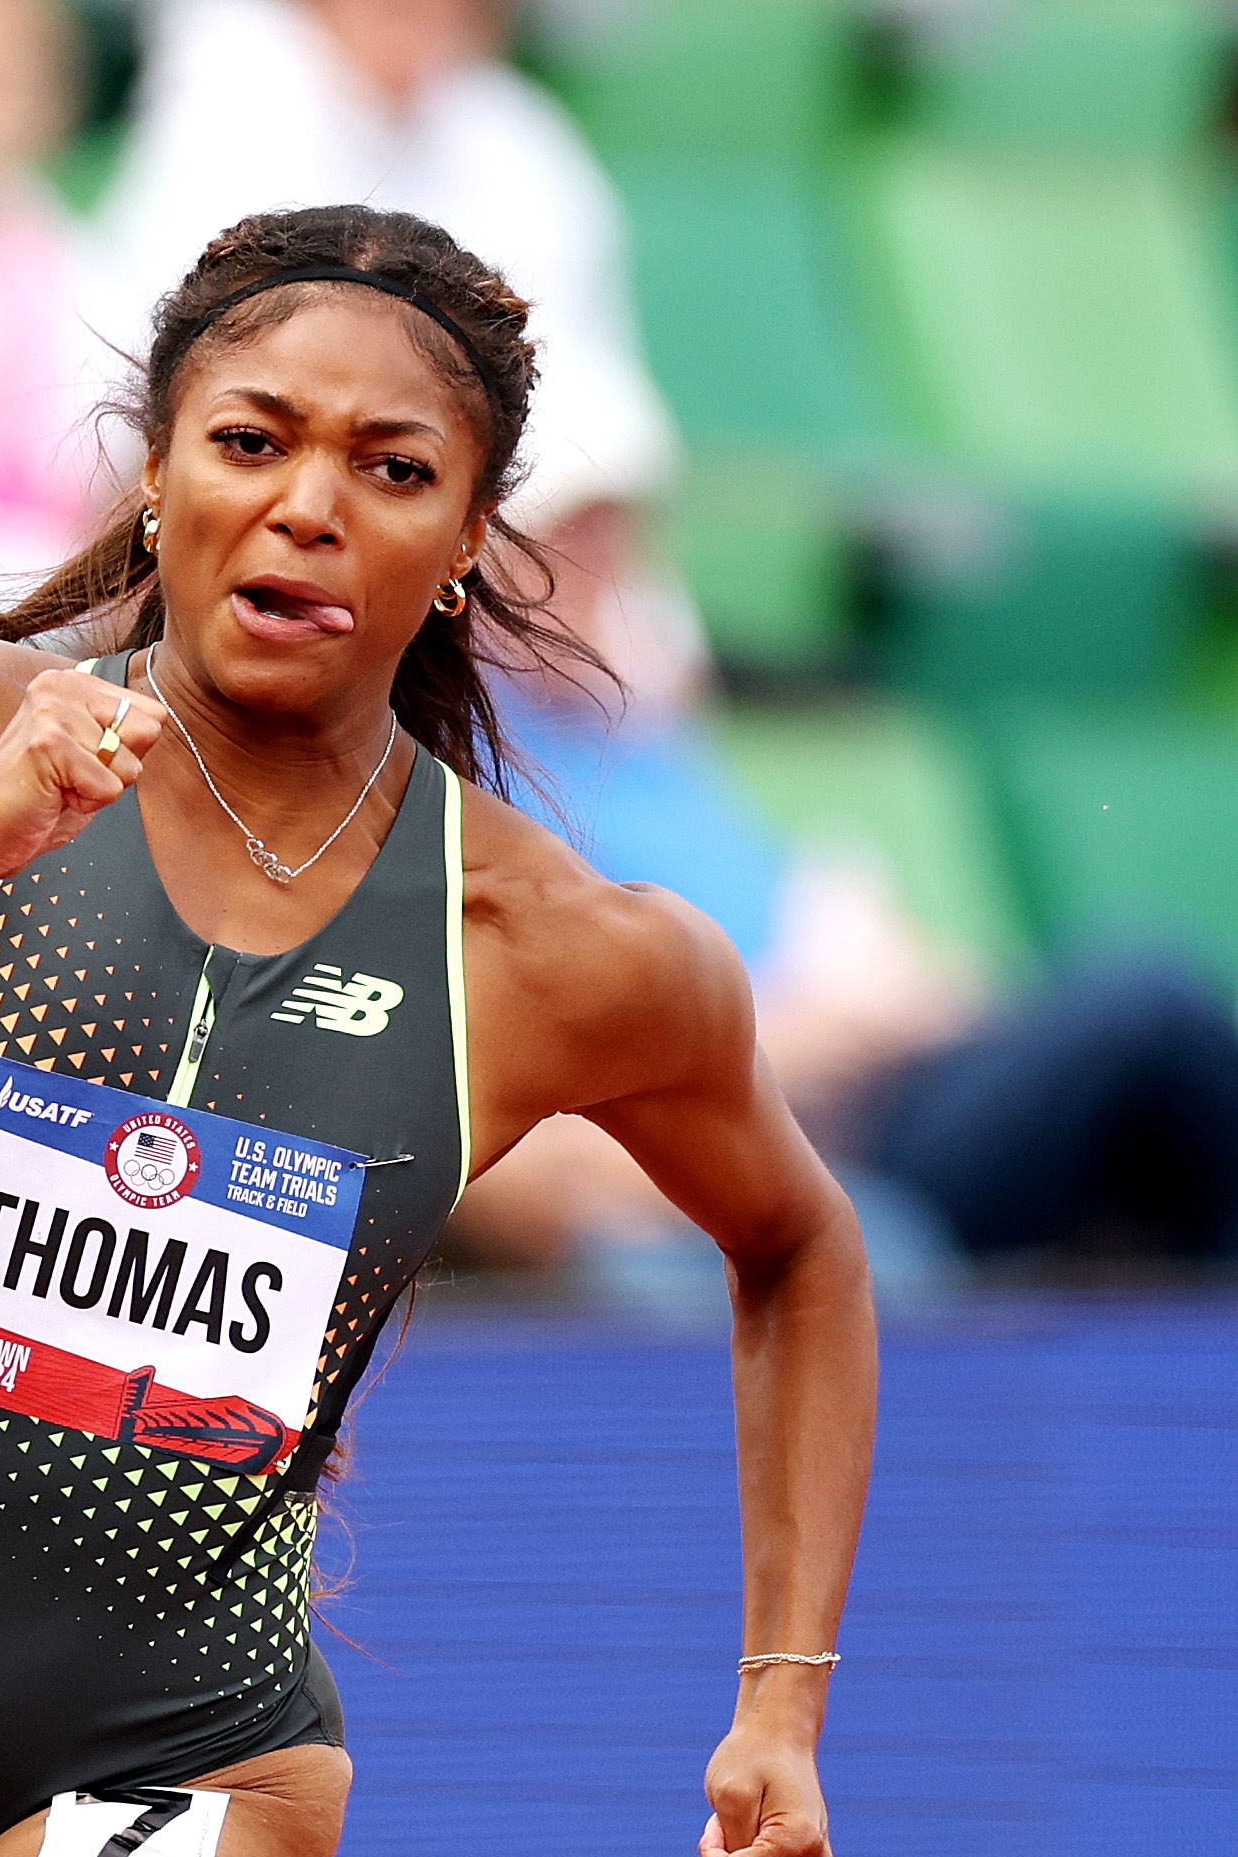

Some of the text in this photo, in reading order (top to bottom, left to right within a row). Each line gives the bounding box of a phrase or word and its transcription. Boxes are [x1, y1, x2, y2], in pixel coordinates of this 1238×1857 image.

[8, 1091, 92, 1128] USATF
[122, 1114, 196, 1149] UNITED STATES
[234, 1136, 342, 1183] U.S. OLYMPIC
[110, 1173, 181, 1207] OLYMPIC TEAM
[226, 1184, 308, 1218] TRACK & FIELD
[230, 1160, 338, 1206] TEAM TRIALS
